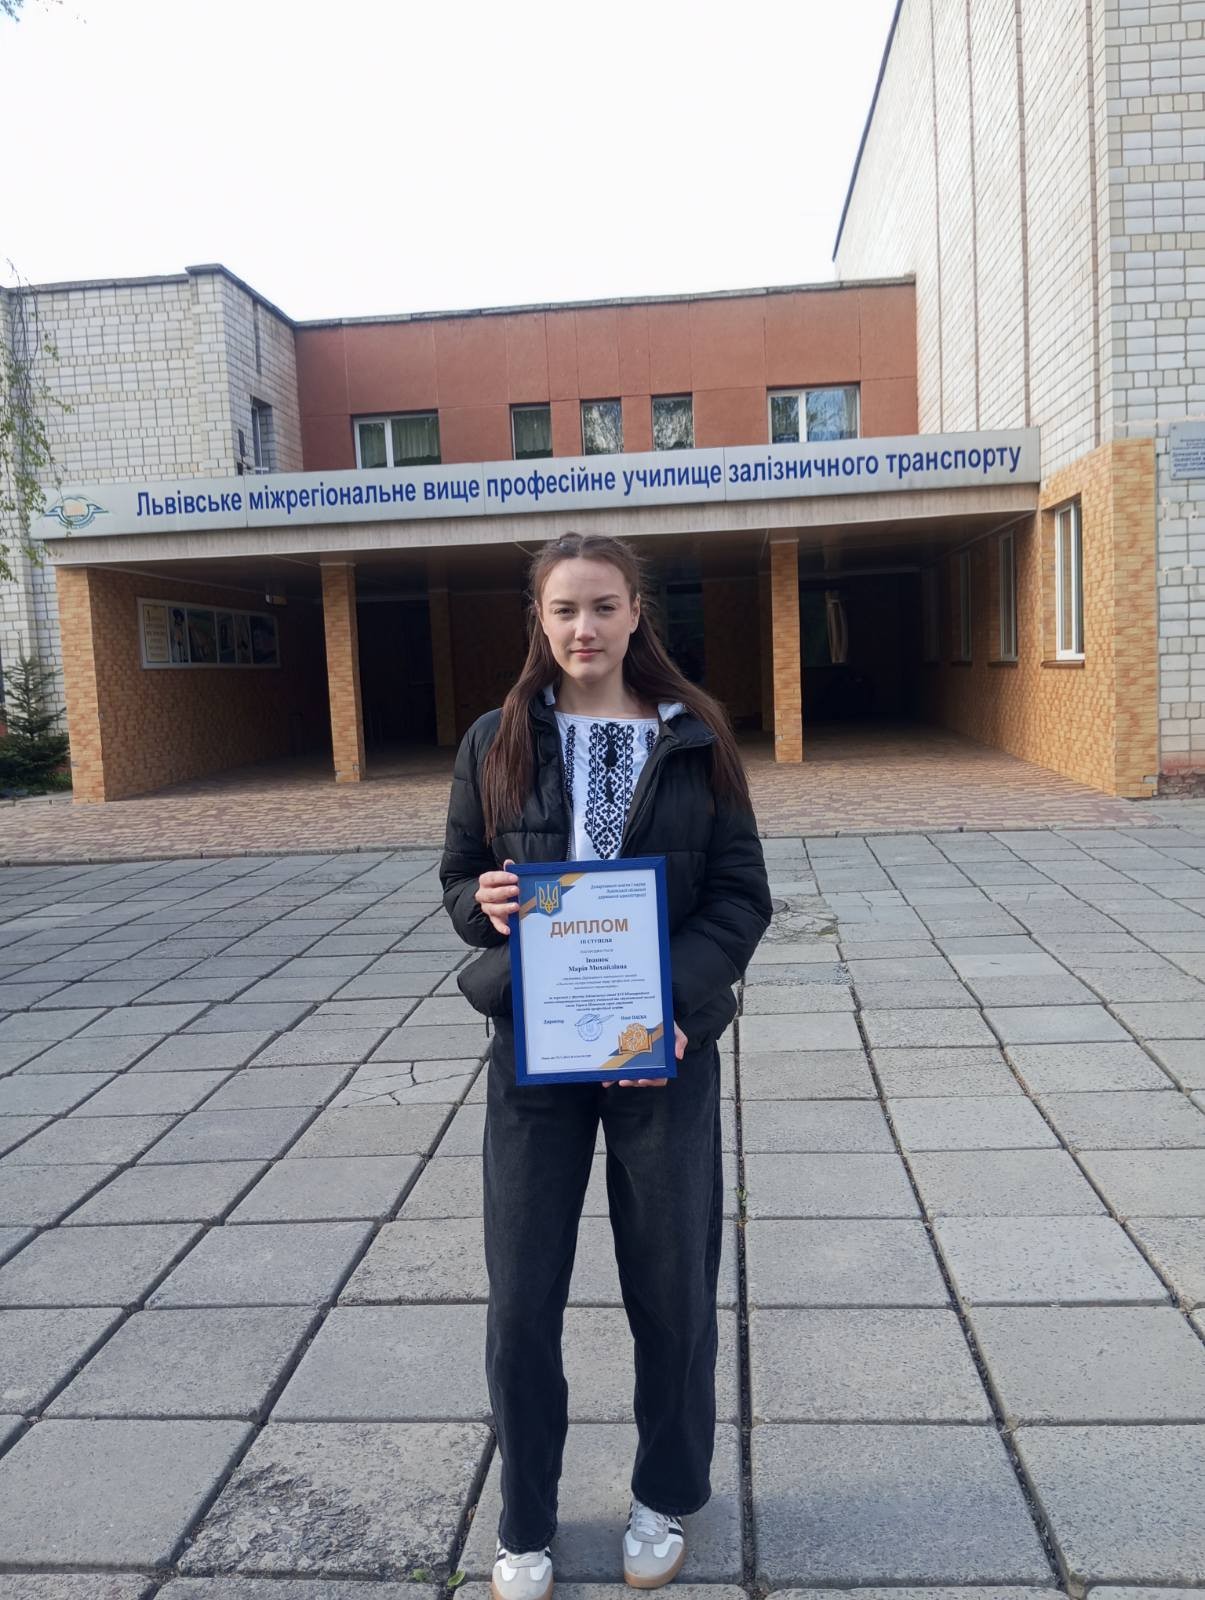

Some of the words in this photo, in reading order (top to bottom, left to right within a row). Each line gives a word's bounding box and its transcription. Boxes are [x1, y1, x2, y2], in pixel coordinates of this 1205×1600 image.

[136, 490, 242, 517] Львівське
[248, 482, 417, 513] міжрегіональне
[423, 480, 480, 504] вище
[486, 467, 616, 504] професійне
[622, 465, 722, 497] училище
[729, 455, 879, 484] залізничного
[885, 447, 1021, 480] транспорту
[550, 918, 629, 938] ДИПЛОМ
